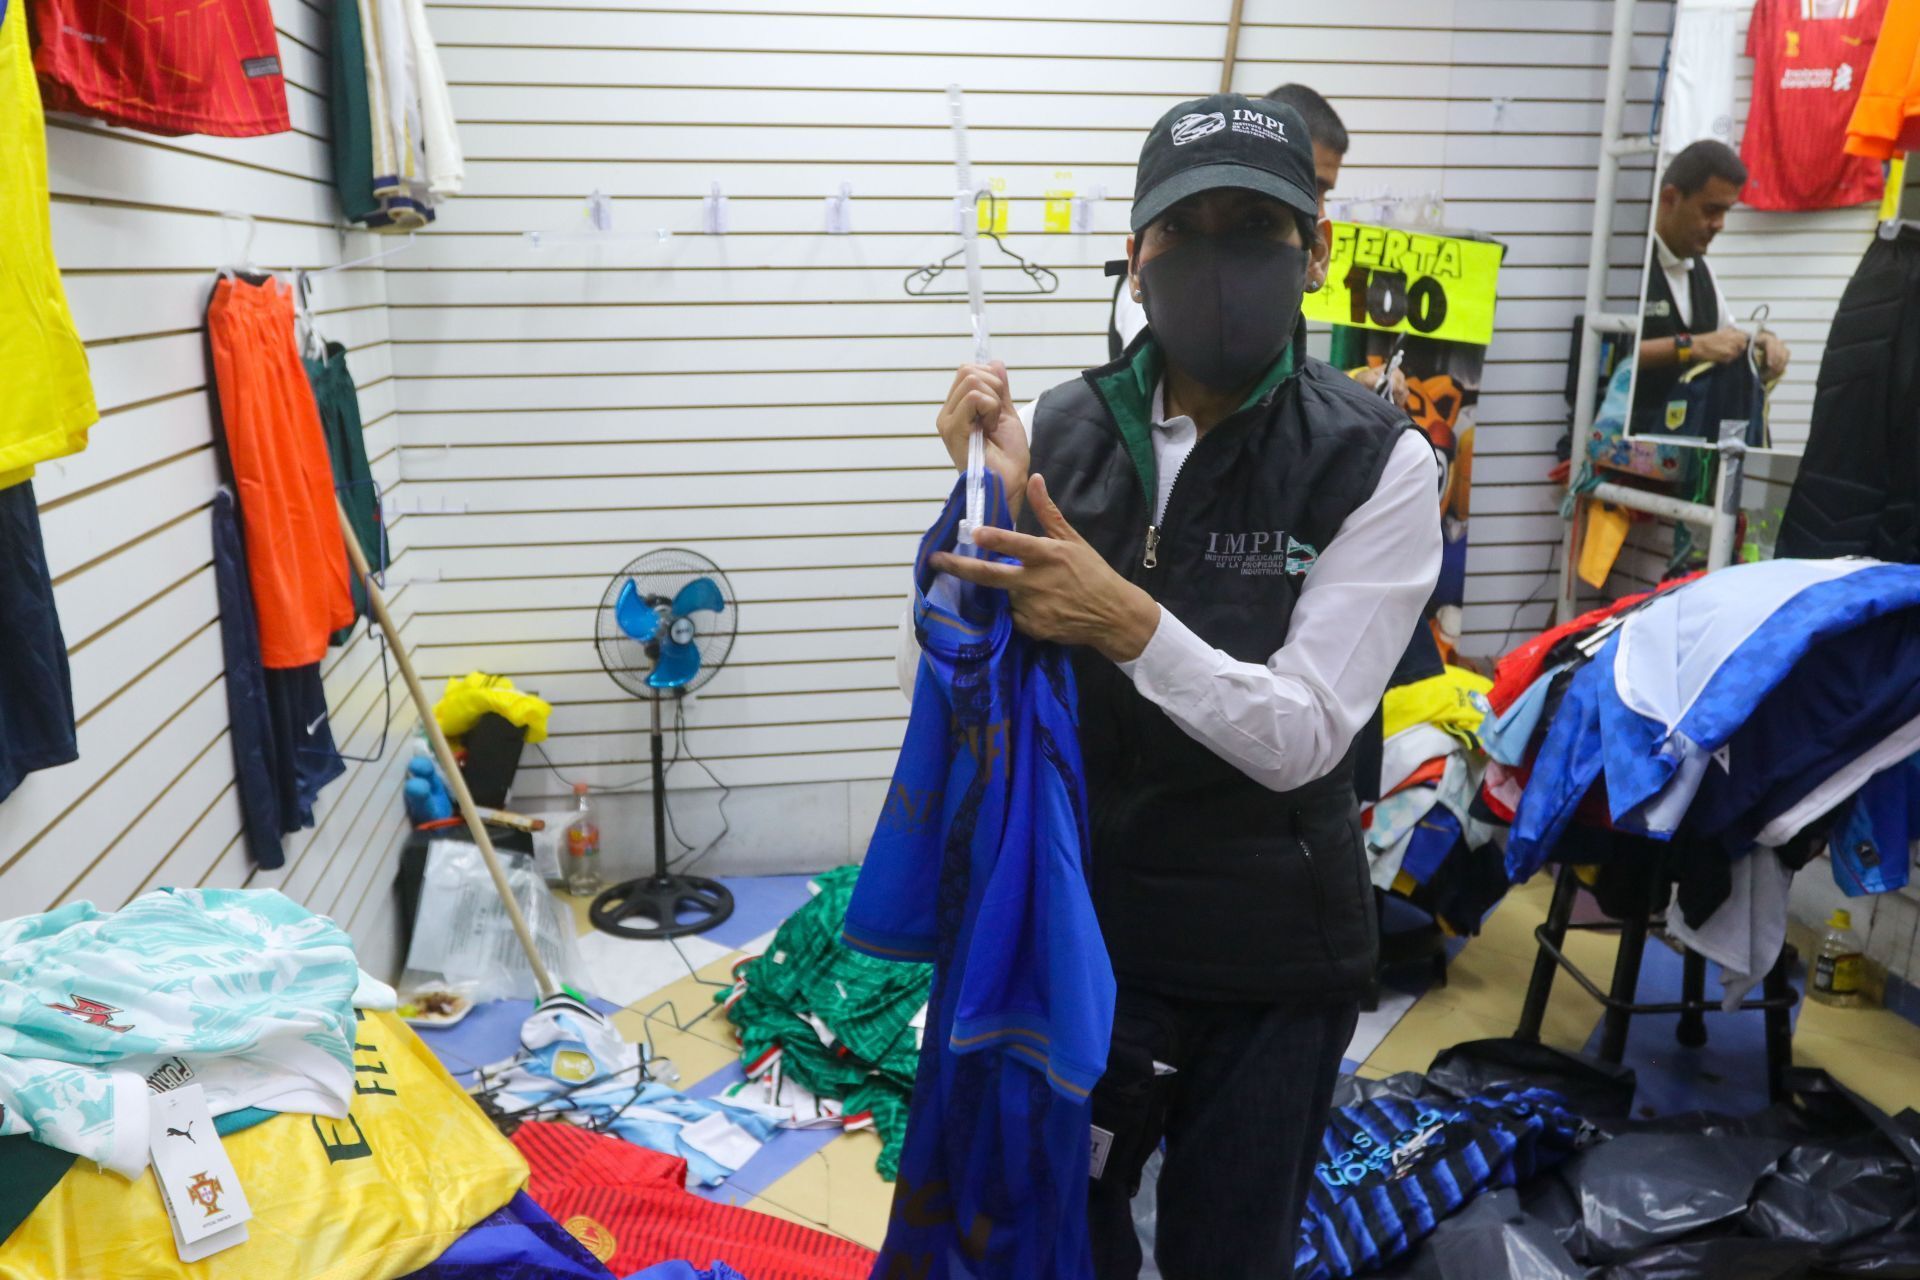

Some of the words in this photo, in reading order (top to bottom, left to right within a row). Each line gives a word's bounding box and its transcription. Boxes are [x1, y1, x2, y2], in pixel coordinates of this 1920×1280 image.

[1232, 109, 1285, 136] IMPI
[1330, 224, 1462, 279] FERTA
[1343, 264, 1448, 334] 100
[1206, 531, 1286, 554] IMPI
[1204, 553, 1242, 562] INSTITUTO
[1246, 553, 1284, 561] MEXICANO
[1242, 561, 1284, 569] PROPIEDAD
[1240, 568, 1284, 576] INDUSTRIAL
